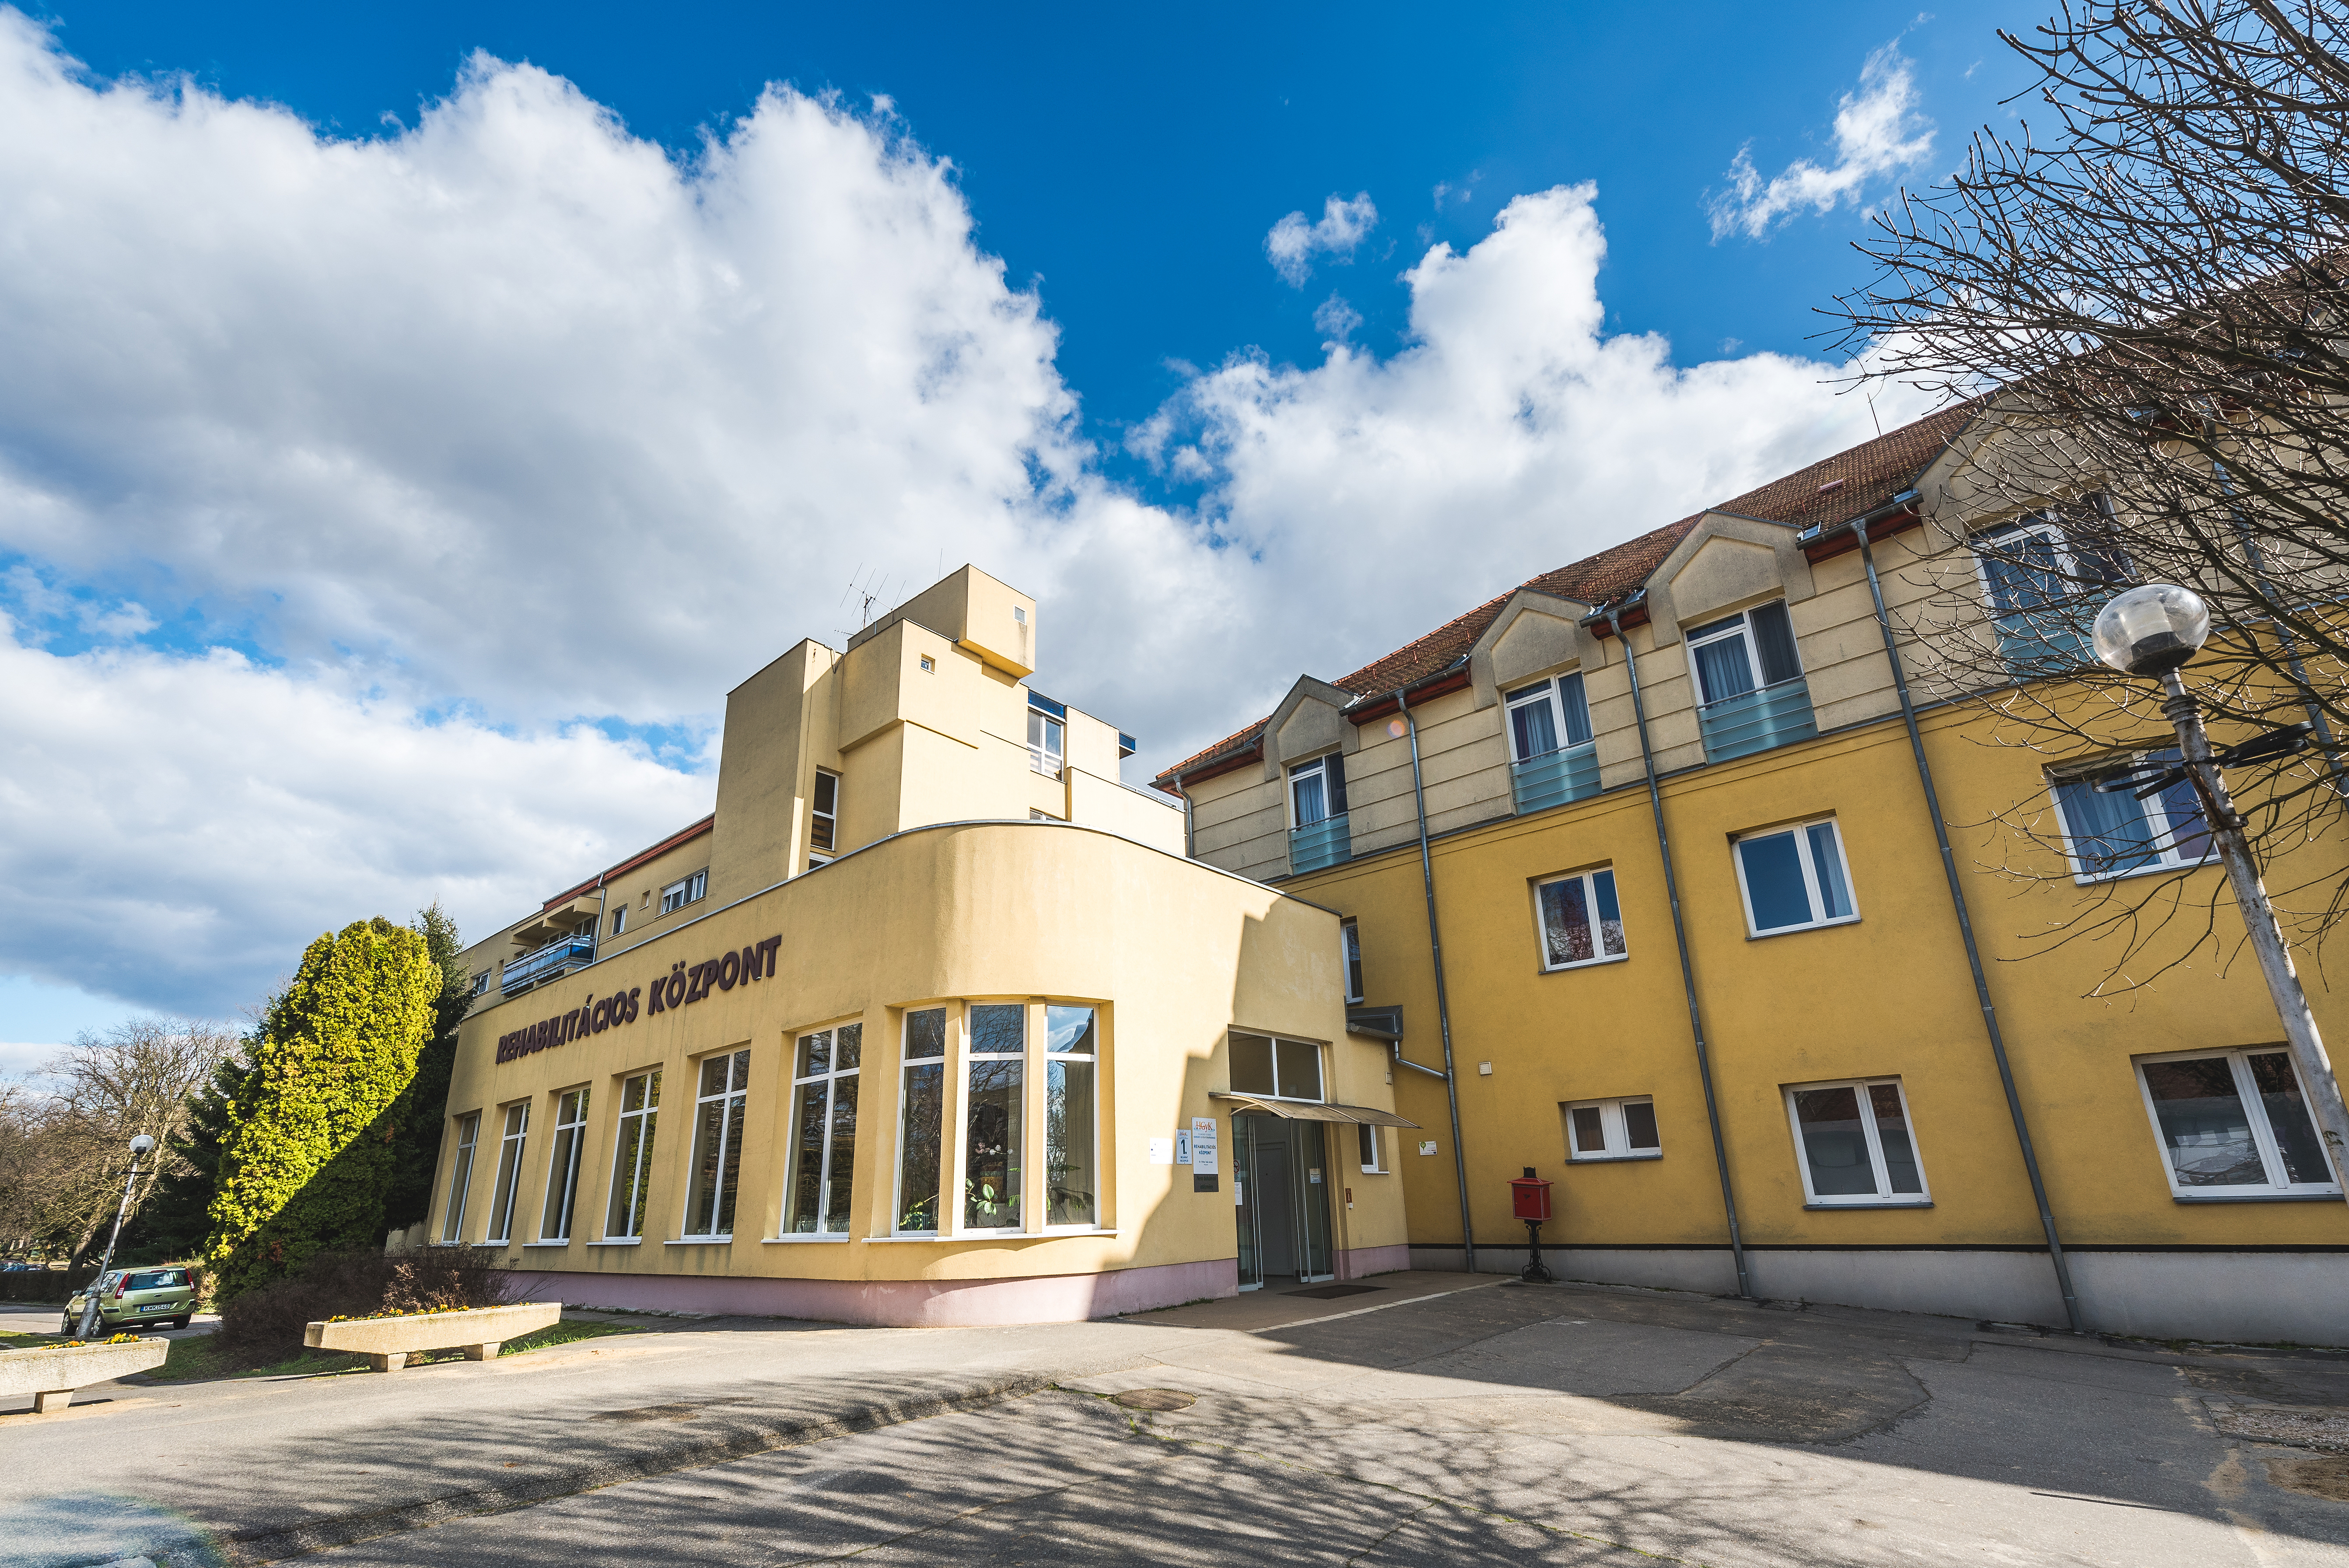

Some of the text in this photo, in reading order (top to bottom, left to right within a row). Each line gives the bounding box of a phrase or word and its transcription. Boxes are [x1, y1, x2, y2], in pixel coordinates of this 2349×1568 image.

[495, 935, 782, 1064] REHABILITÁCIOS KÖZPONT
[1196, 1121, 1213, 1133] HGyK
